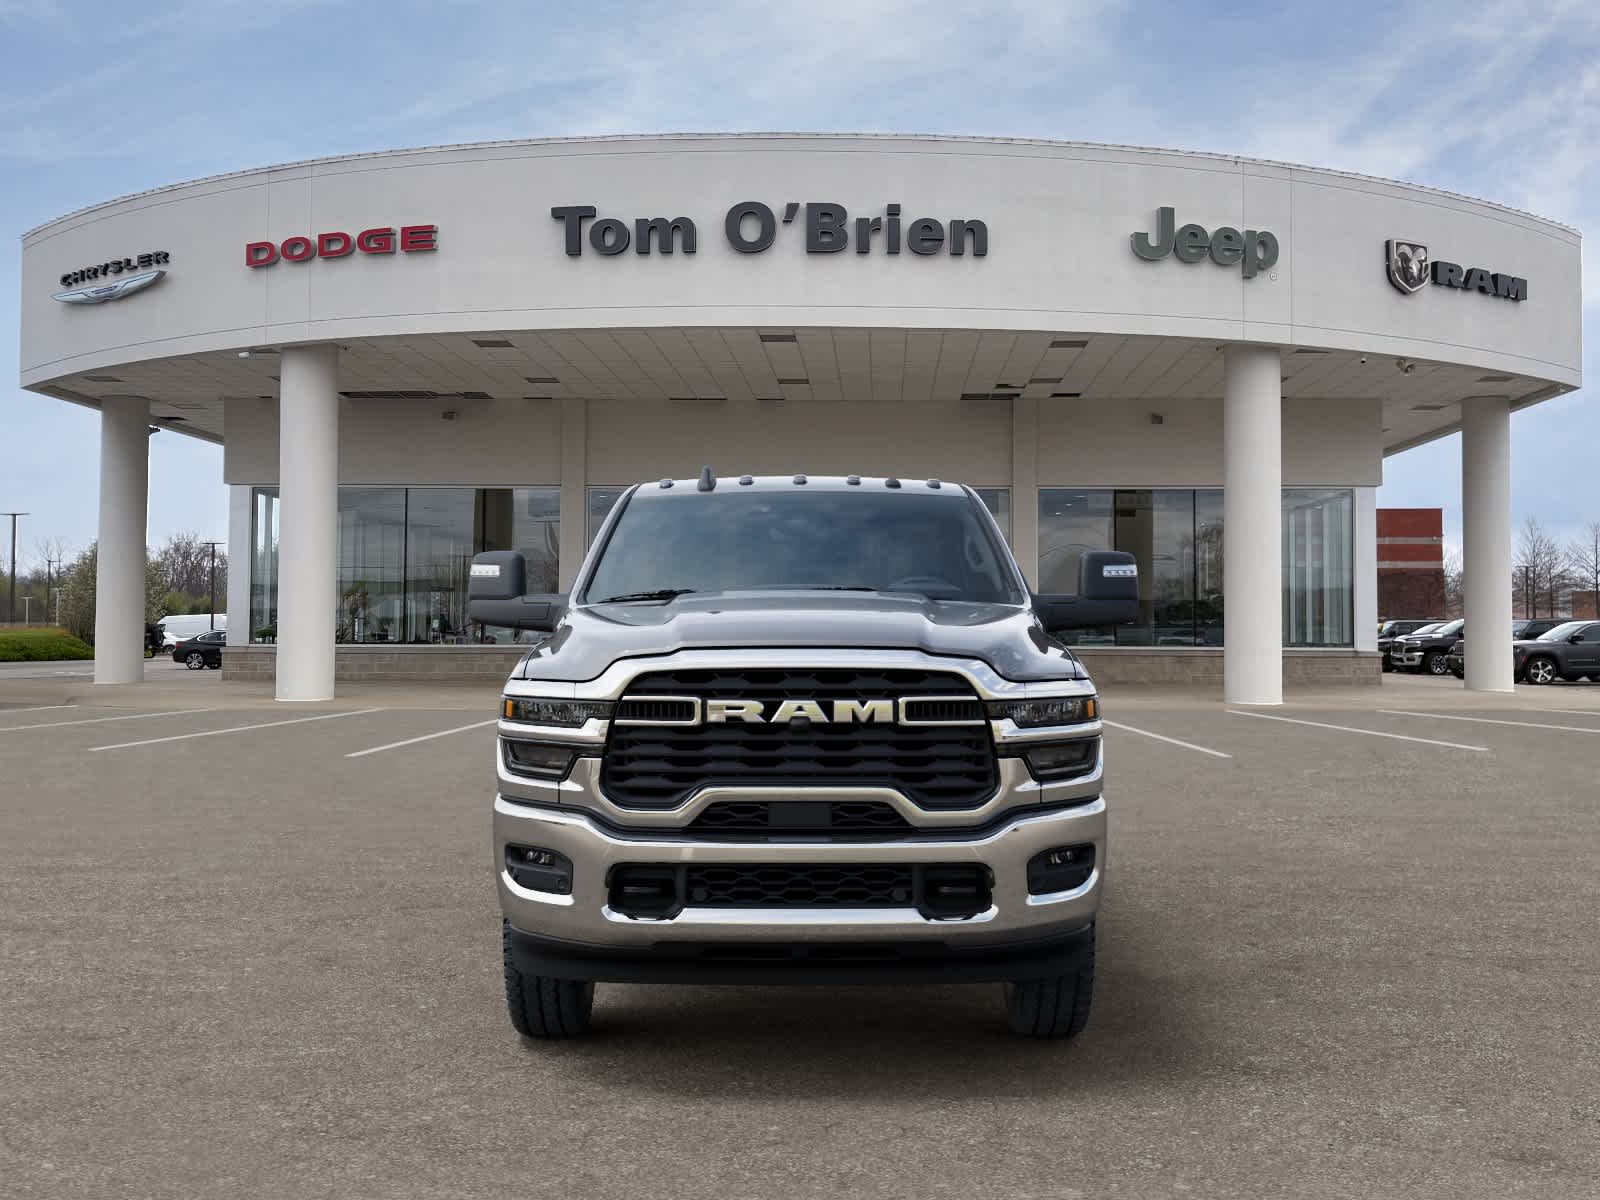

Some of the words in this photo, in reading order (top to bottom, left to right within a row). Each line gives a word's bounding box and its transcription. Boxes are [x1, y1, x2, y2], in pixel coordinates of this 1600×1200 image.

[245, 224, 438, 268] DODGE
[551, 206, 697, 256] Tom
[725, 201, 989, 257] O'Brien
[1130, 207, 1280, 279] Jeep
[60, 250, 169, 286] CHRYSLER
[1431, 261, 1528, 301] RAM
[706, 699, 894, 723] RAM
